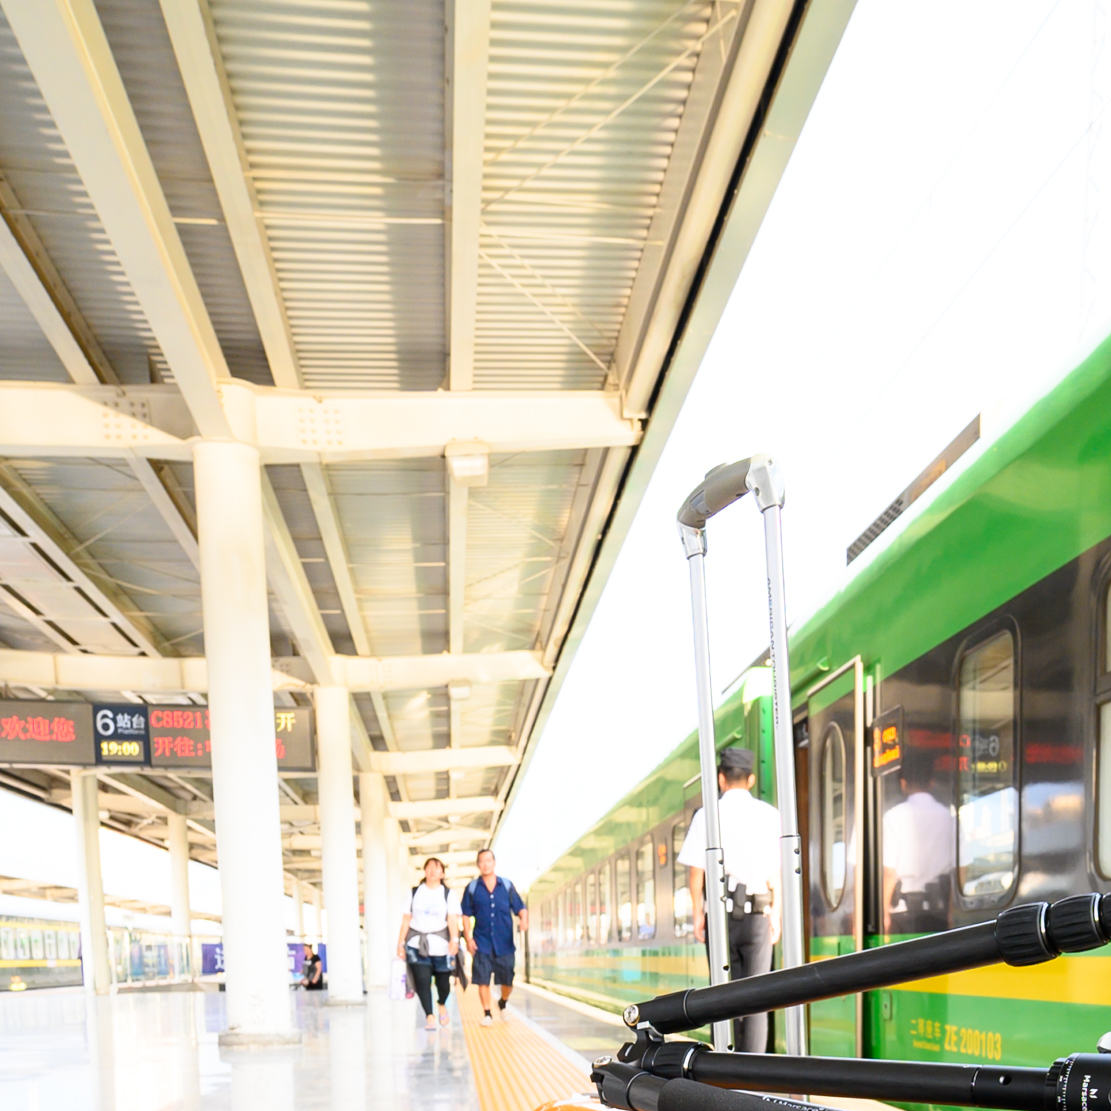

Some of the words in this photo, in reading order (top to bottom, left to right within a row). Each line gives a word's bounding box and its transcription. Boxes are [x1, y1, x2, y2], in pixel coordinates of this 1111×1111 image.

[1, 715, 76, 742] 欢迎您
[96, 709, 115, 736] 6
[116, 713, 145, 730] 站台
[276, 712, 296, 732] 开
[100, 741, 139, 756] 19:00
[944, 1024, 958, 1052] ZE
[960, 1027, 1002, 1061] 200103
